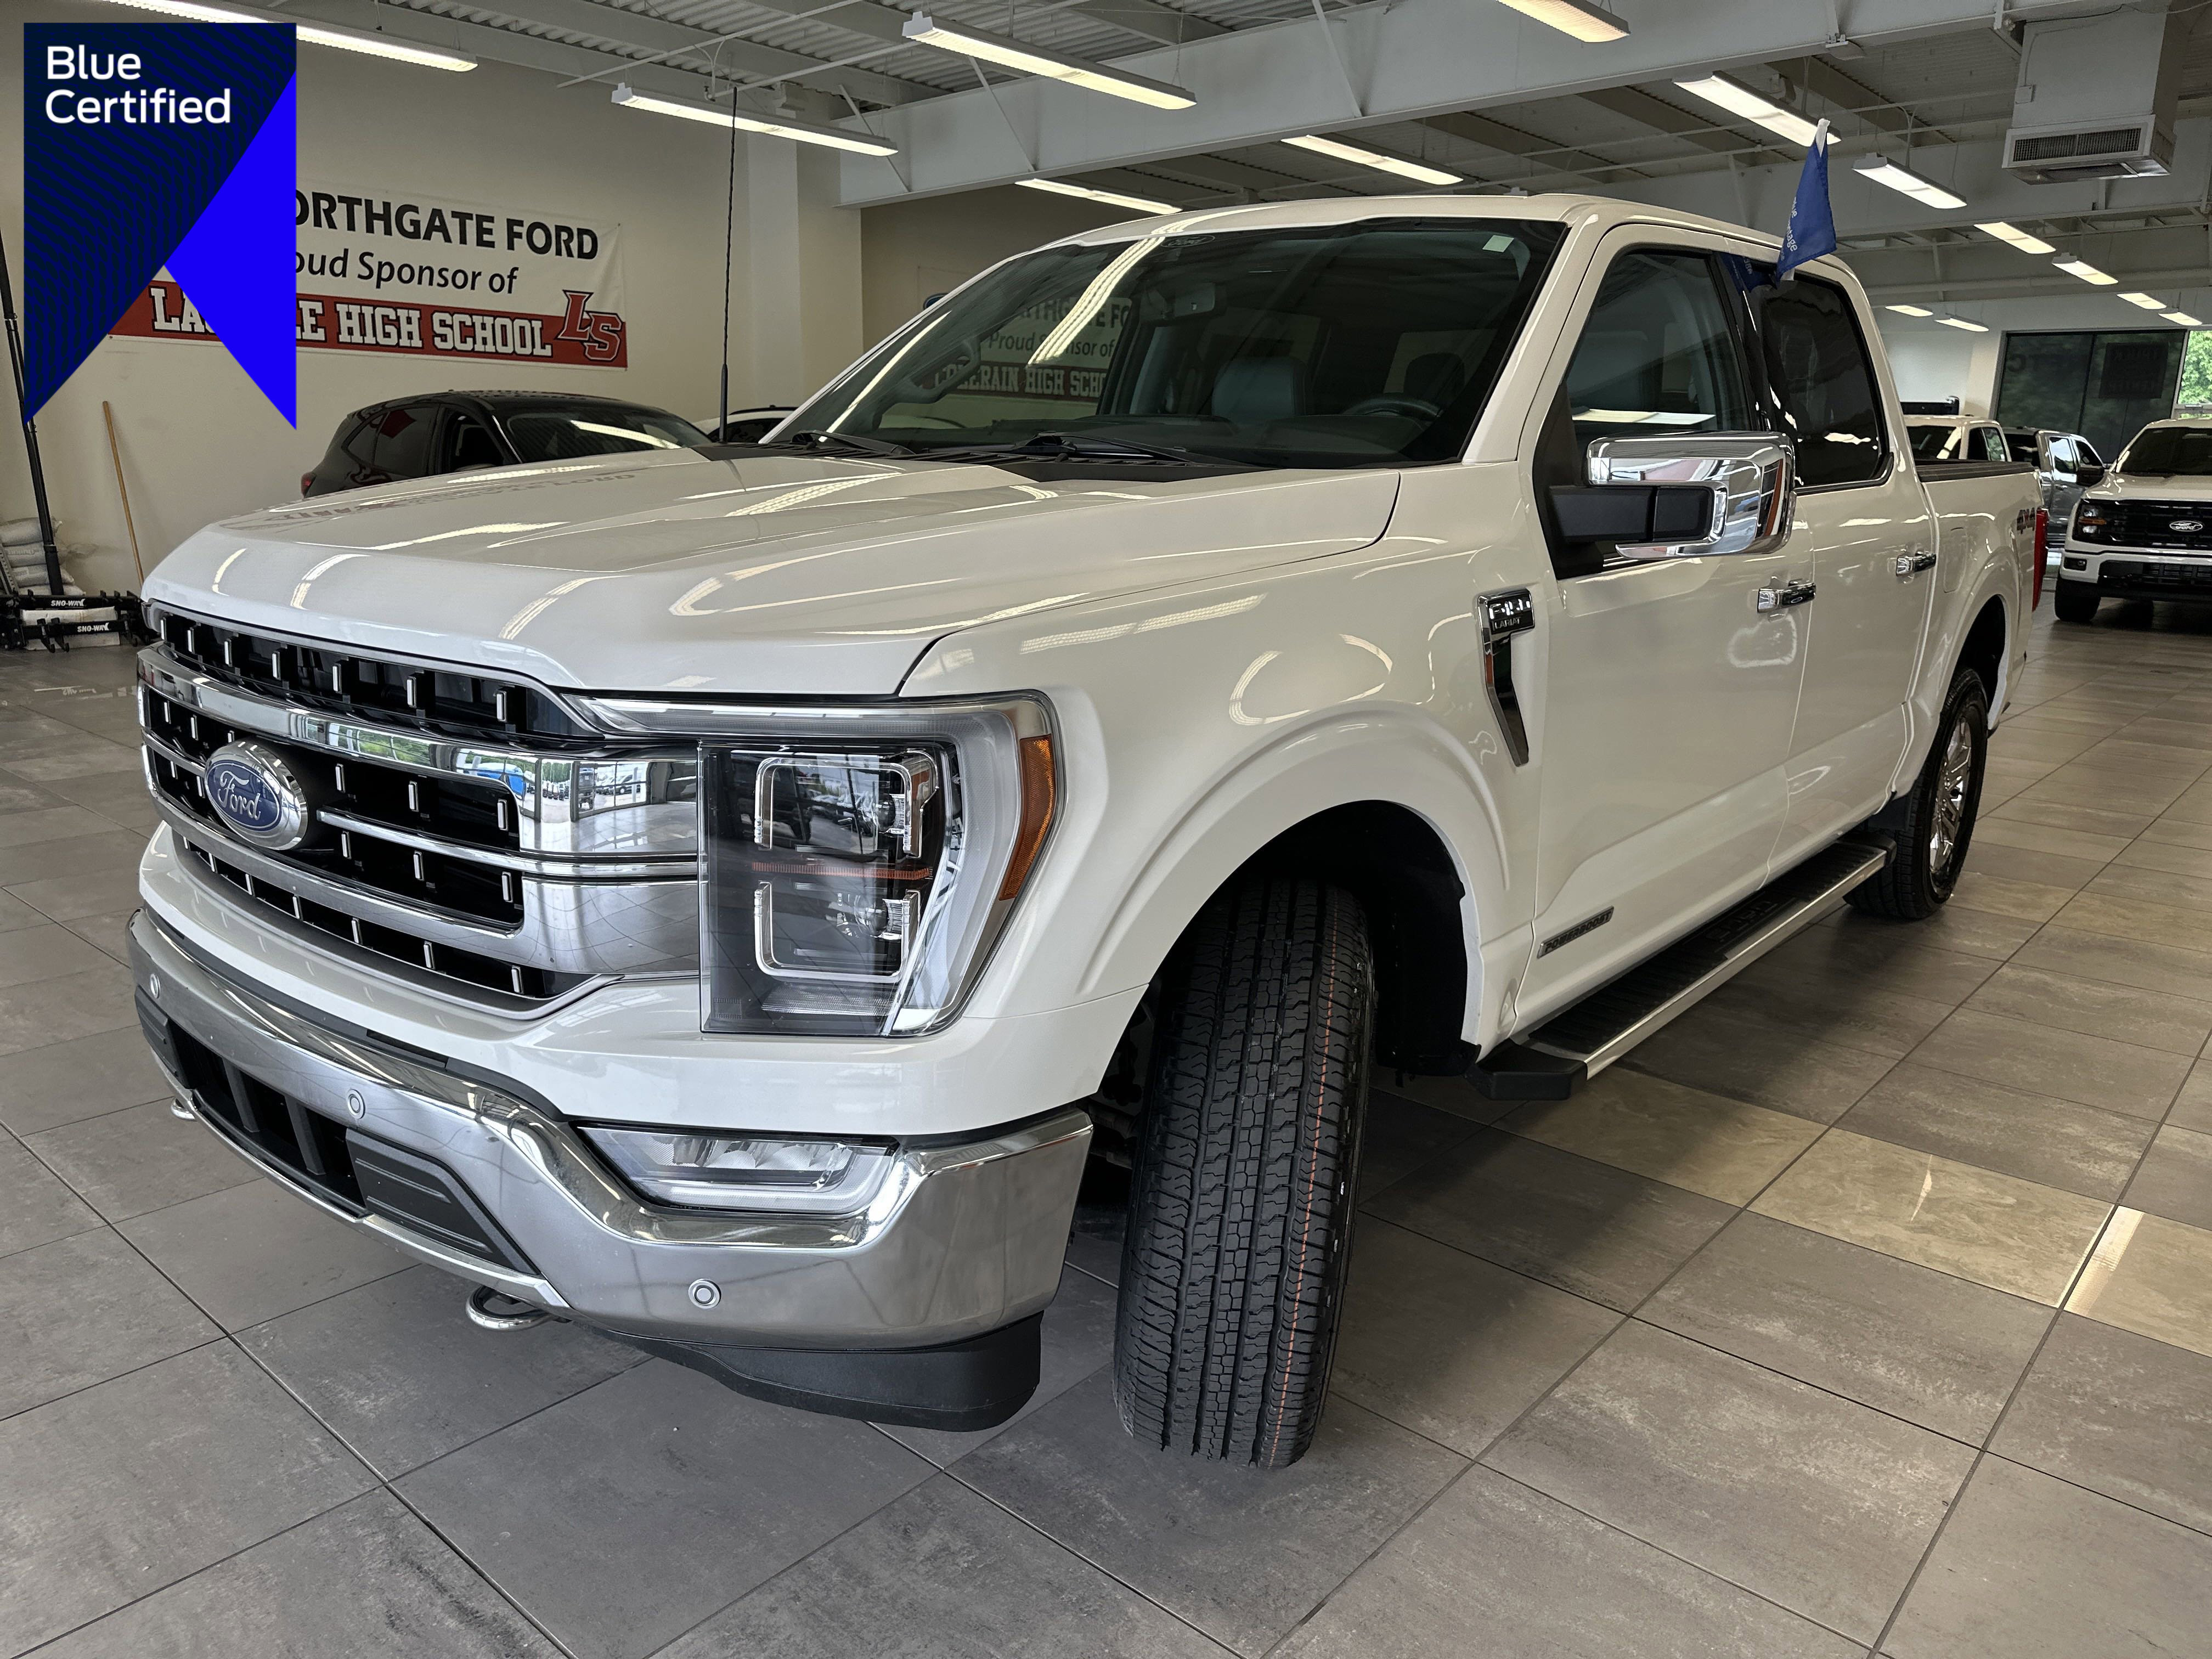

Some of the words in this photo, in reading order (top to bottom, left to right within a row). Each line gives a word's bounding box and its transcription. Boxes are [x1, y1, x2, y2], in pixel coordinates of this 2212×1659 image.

[506, 218, 599, 260] FORD
[357, 251, 482, 291] Sponsor
[488, 267, 519, 295] of
[336, 302, 423, 348] HIGH
[432, 311, 552, 357] SCHOOL
[554, 289, 623, 362] LS
[988, 332, 1036, 351] Proud
[1100, 339, 1116, 358] of
[1024, 368, 1065, 396] HIGH
[50, 598, 86, 607] SNO-WAY
[1494, 617, 1522, 629] LARIAT
[77, 622, 110, 633] SNO-WAY
[217, 770, 262, 821] Ford
[1544, 911, 1612, 953] POWERBOOST
